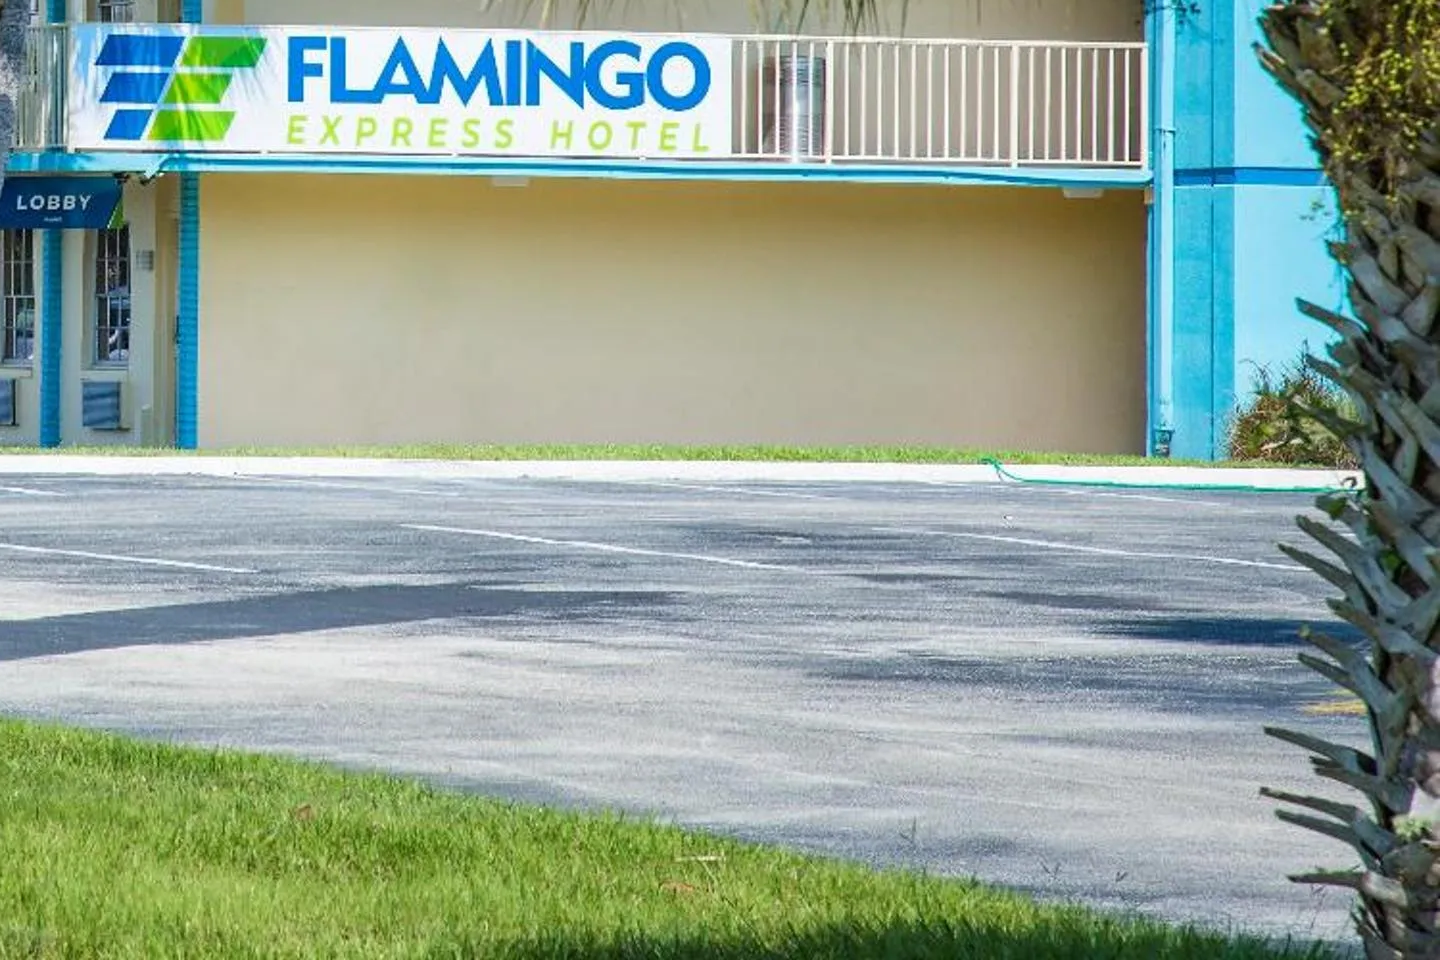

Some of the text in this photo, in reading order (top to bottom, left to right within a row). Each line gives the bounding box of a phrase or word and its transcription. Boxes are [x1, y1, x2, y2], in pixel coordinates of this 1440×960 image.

[288, 35, 711, 112] FLAMINGO
[287, 115, 710, 152] EXPRESS HOTEL
[16, 195, 91, 210] LOBBY
